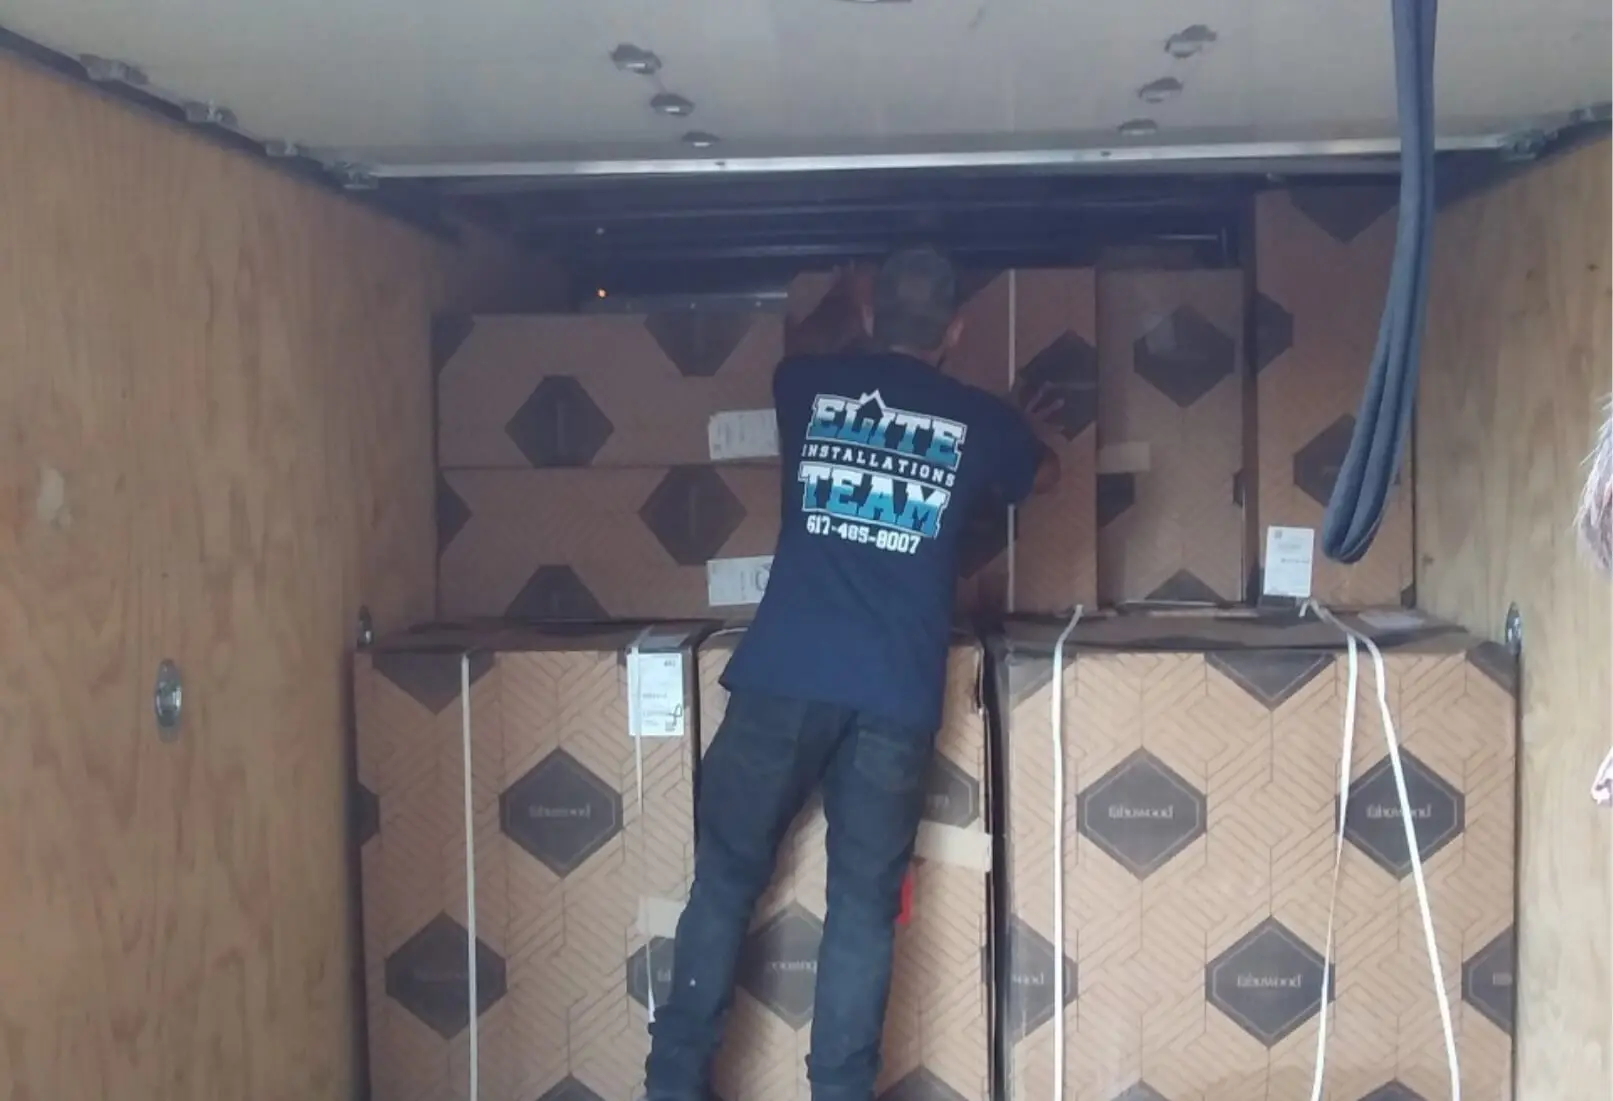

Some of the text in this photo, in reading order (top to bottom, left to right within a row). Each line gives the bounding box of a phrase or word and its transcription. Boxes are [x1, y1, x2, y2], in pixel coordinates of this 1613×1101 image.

[802, 444, 956, 487] INSTALLATIONS
[806, 394, 966, 470] ELITE
[799, 462, 950, 539] TEAM
